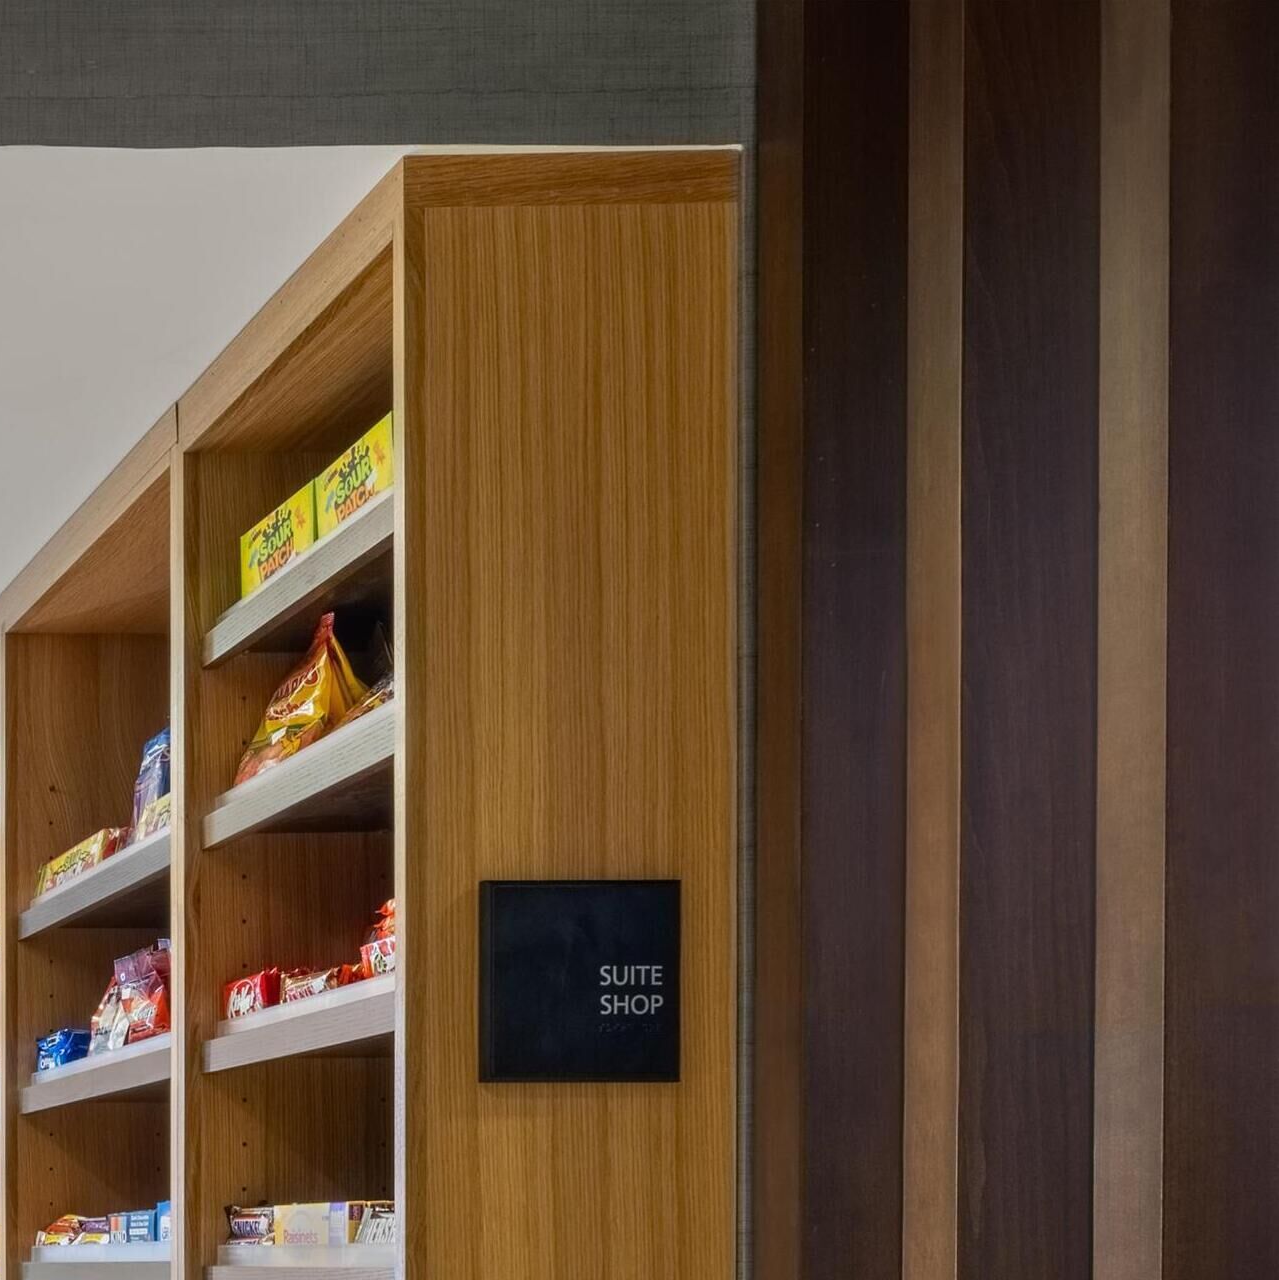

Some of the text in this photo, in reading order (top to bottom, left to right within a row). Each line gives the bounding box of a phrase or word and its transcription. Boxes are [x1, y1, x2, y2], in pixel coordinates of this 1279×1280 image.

[335, 456, 373, 505] SOUR
[257, 518, 293, 562] SOUR
[599, 964, 664, 986] SUITE
[599, 994, 665, 1016] SHOP
